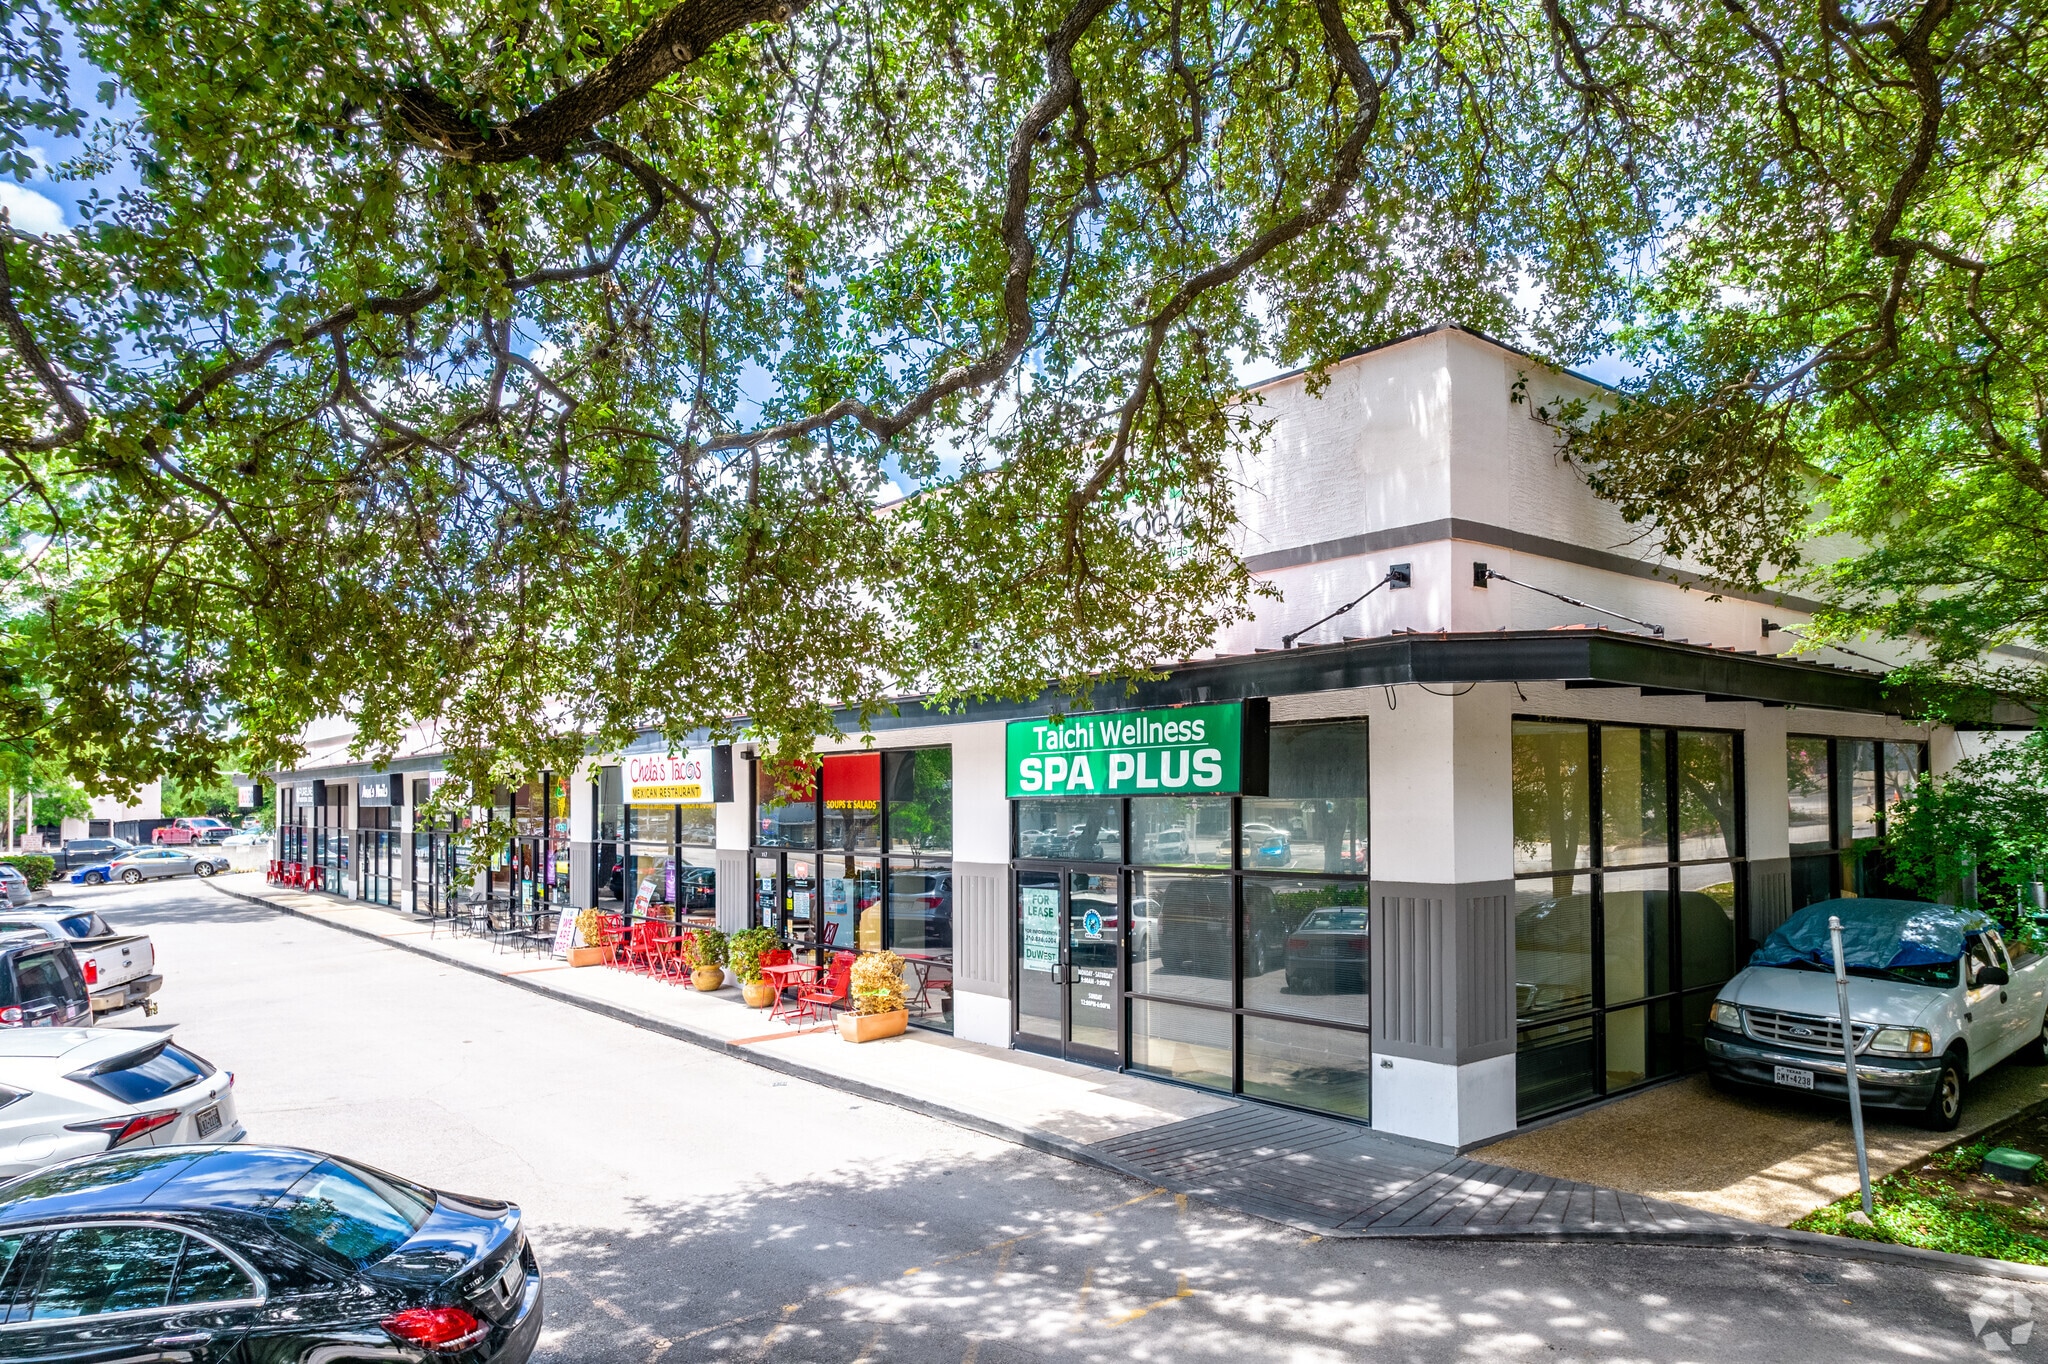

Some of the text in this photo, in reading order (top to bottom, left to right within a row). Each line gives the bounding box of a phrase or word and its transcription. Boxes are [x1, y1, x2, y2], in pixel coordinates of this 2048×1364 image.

[1033, 717, 1205, 750] Taichi Wellness
[630, 756, 701, 783] Chela's Tacos
[1019, 748, 1222, 792] SPA PLUS
[375, 783, 388, 798] Nails
[632, 786, 700, 798] MEXICAN RESTAURANT
[826, 800, 877, 809] SOUPS & SALADS
[1032, 894, 1049, 905] FOR
[1027, 906, 1054, 918] LEASE
[563, 918, 573, 928] WE
[559, 930, 571, 941] ARE
[1095, 971, 1114, 980] SATURDAY
[1088, 992, 1103, 1001] SUNDAY
